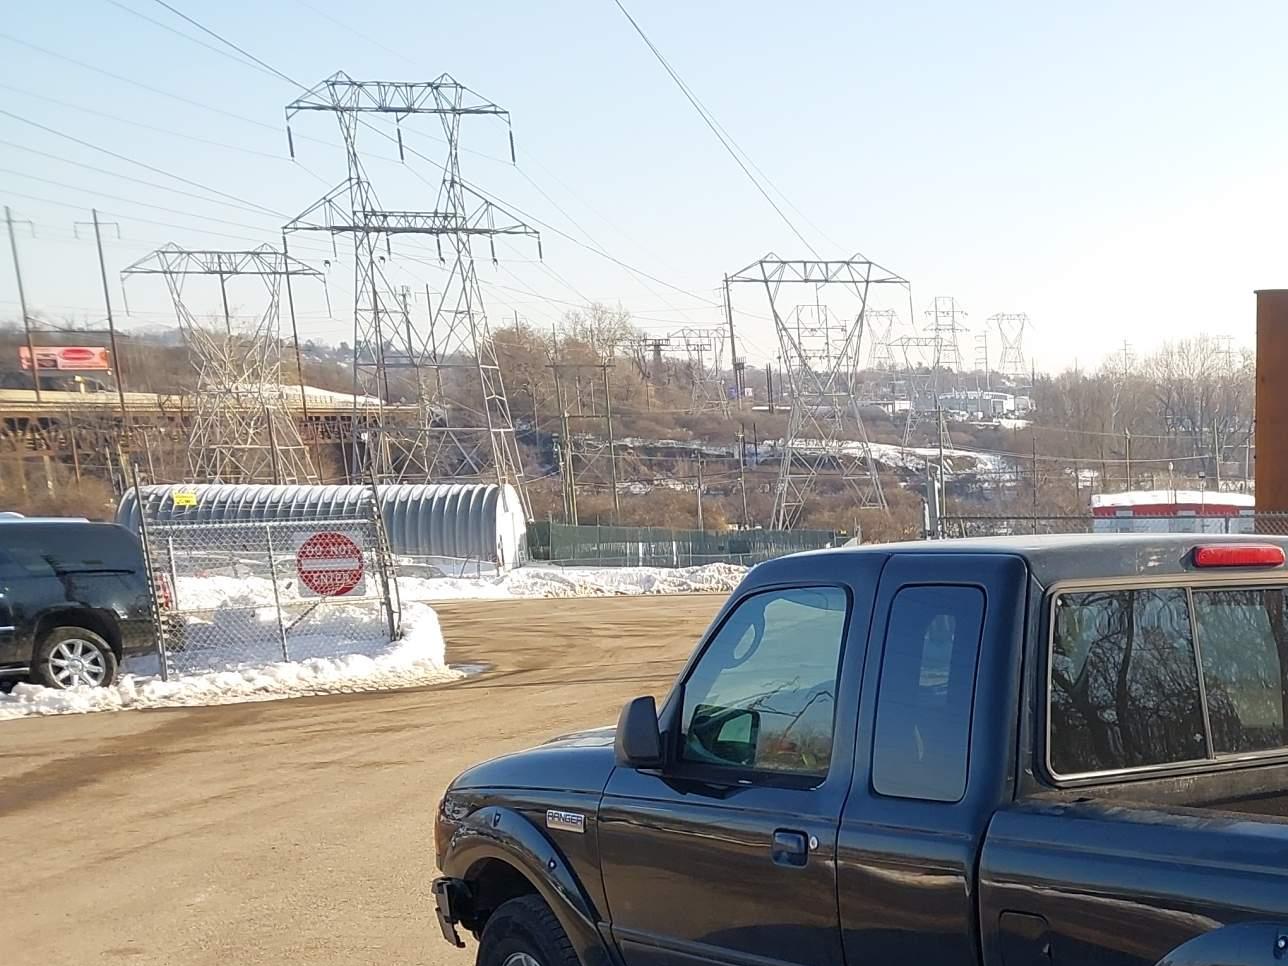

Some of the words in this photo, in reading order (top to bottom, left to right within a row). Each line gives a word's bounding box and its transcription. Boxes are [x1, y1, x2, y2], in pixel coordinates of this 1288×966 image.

[305, 545, 323, 555] DO
[314, 572, 350, 584] ENTER
[547, 811, 583, 825] RANGER
